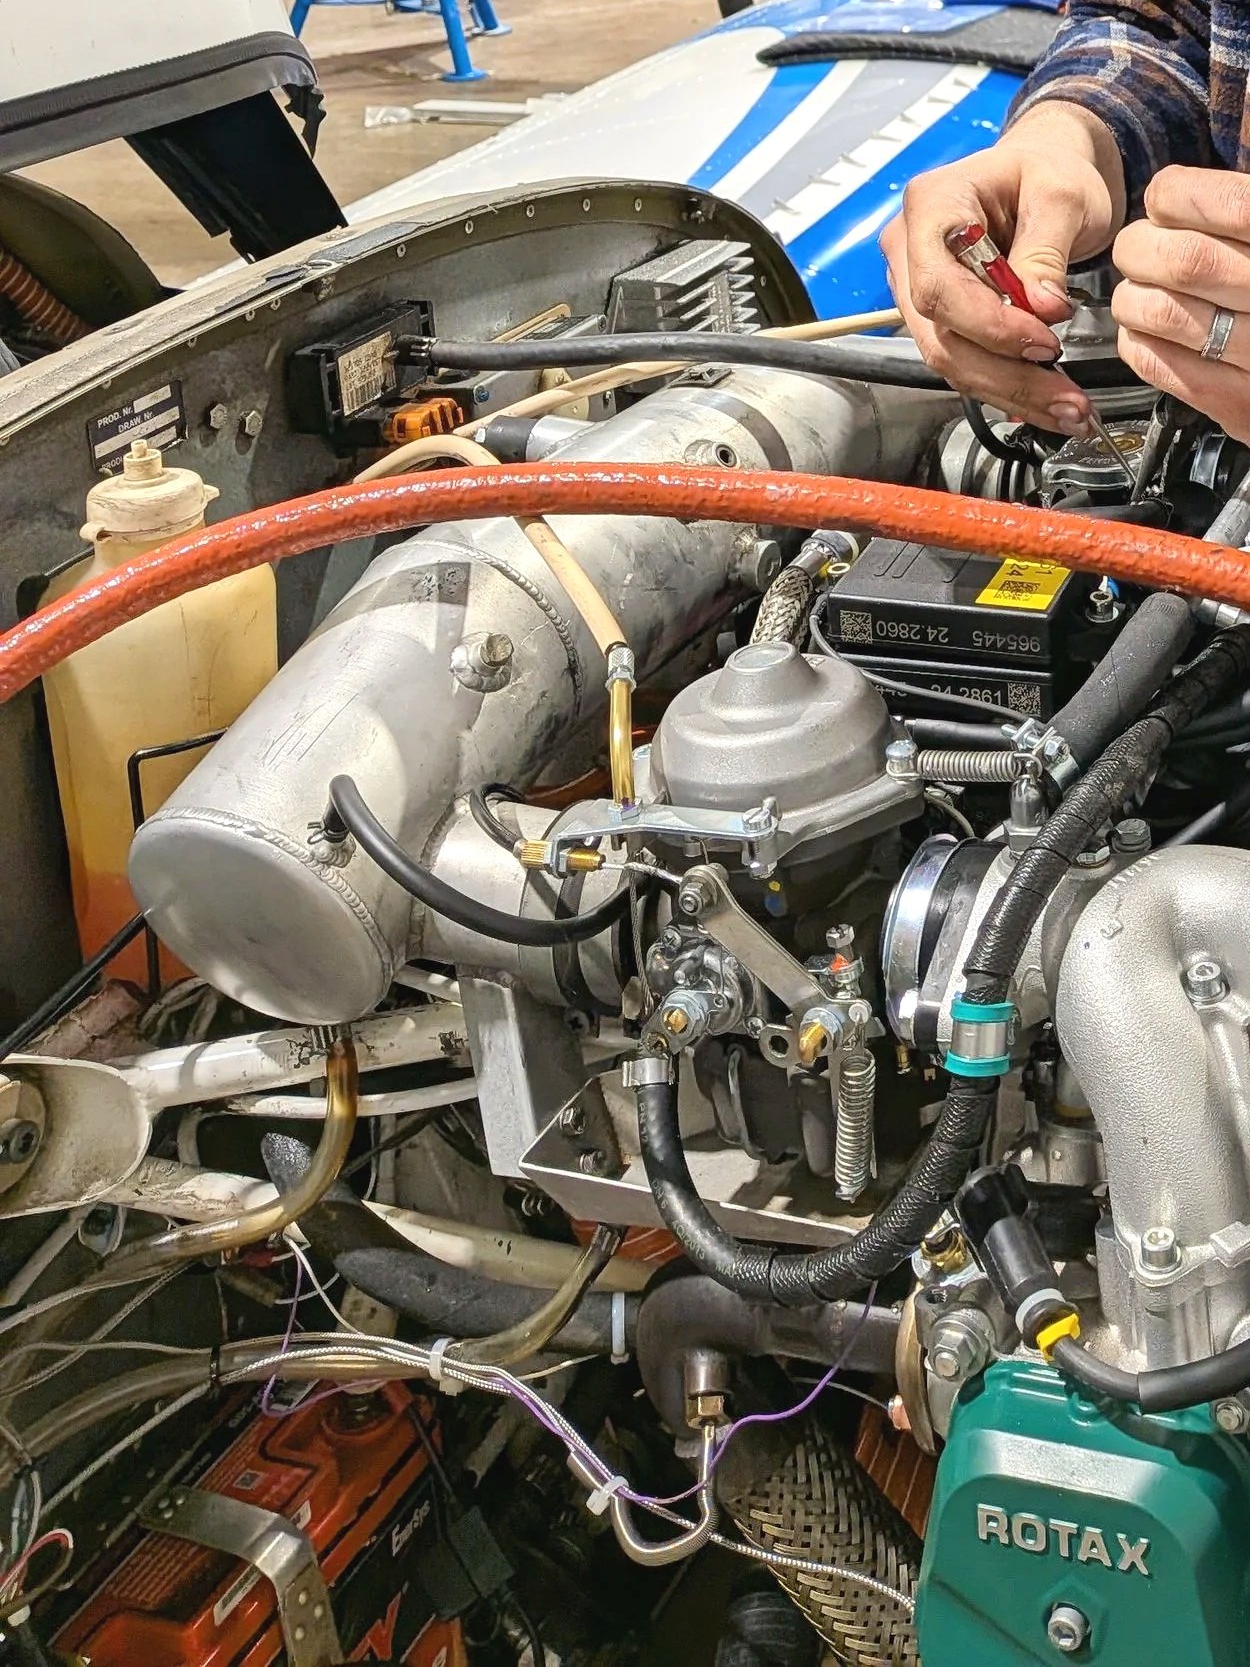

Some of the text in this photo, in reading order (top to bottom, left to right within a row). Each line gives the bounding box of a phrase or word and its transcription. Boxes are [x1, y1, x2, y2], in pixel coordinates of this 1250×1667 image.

[97, 405, 133, 429] PROD. Nr.
[118, 410, 155, 433] DRAW. Nr.
[876, 620, 1041, 653] 965445 24.2860
[976, 1502, 1151, 1576] ROTAX
